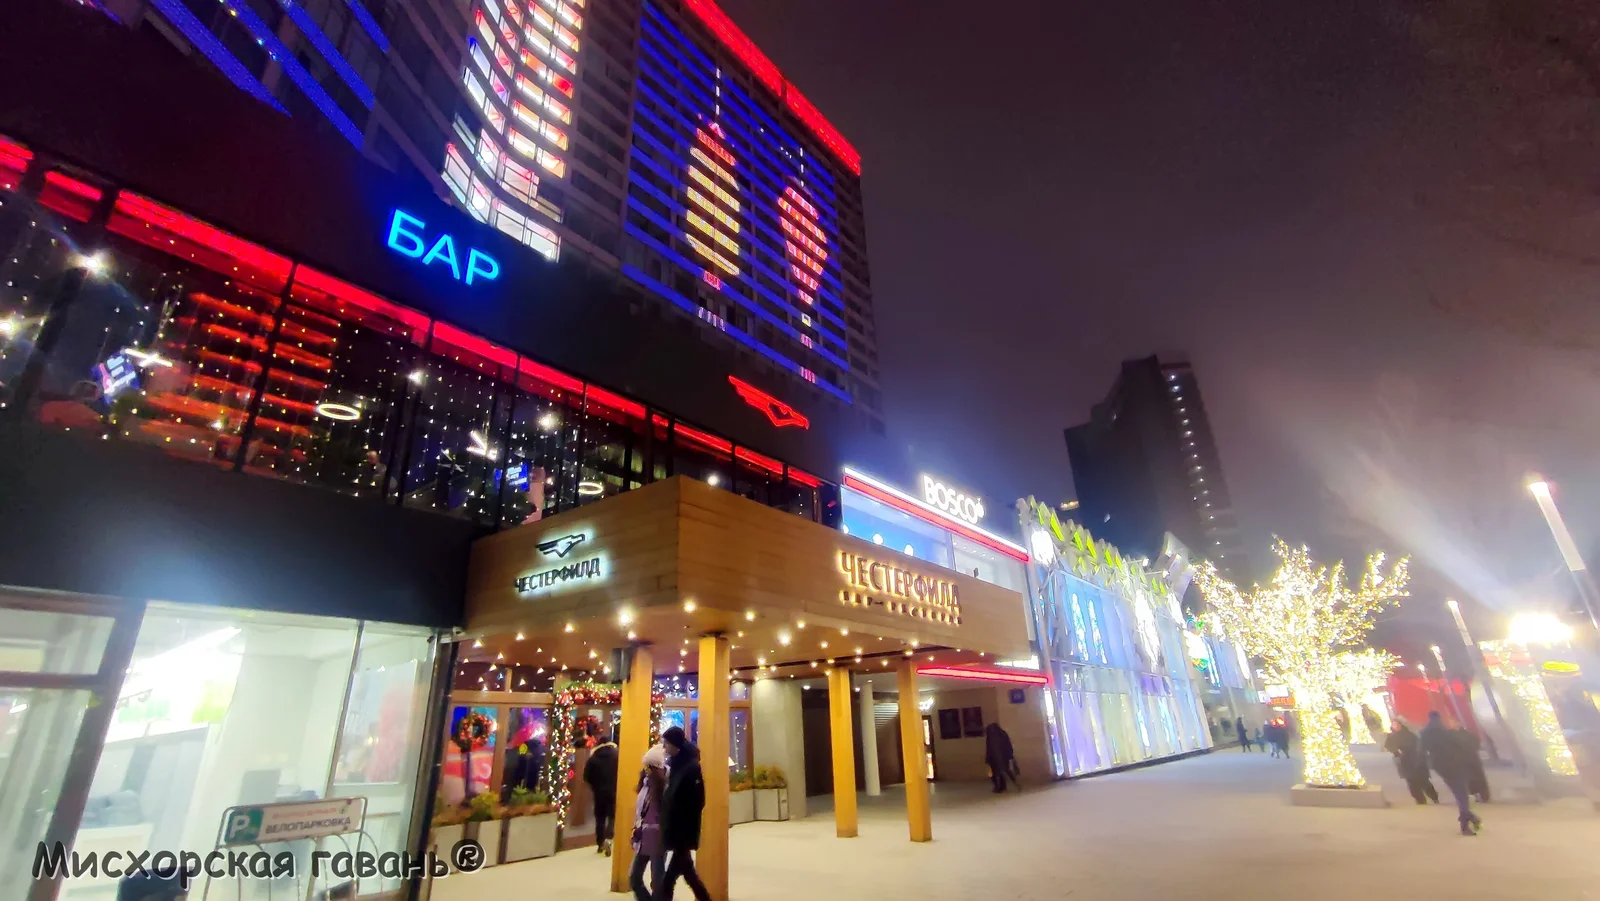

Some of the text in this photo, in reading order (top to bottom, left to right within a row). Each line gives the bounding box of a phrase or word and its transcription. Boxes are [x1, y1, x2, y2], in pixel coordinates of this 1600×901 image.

[387, 208, 499, 286] БАР
[923, 474, 978, 525] BOSCO
[514, 557, 601, 593] ЧЕСТЕРФИЛД
[840, 551, 962, 613] ЧЕСТЕРФИЛД
[265, 816, 351, 834] ВЕЛОПАРКОВКА
